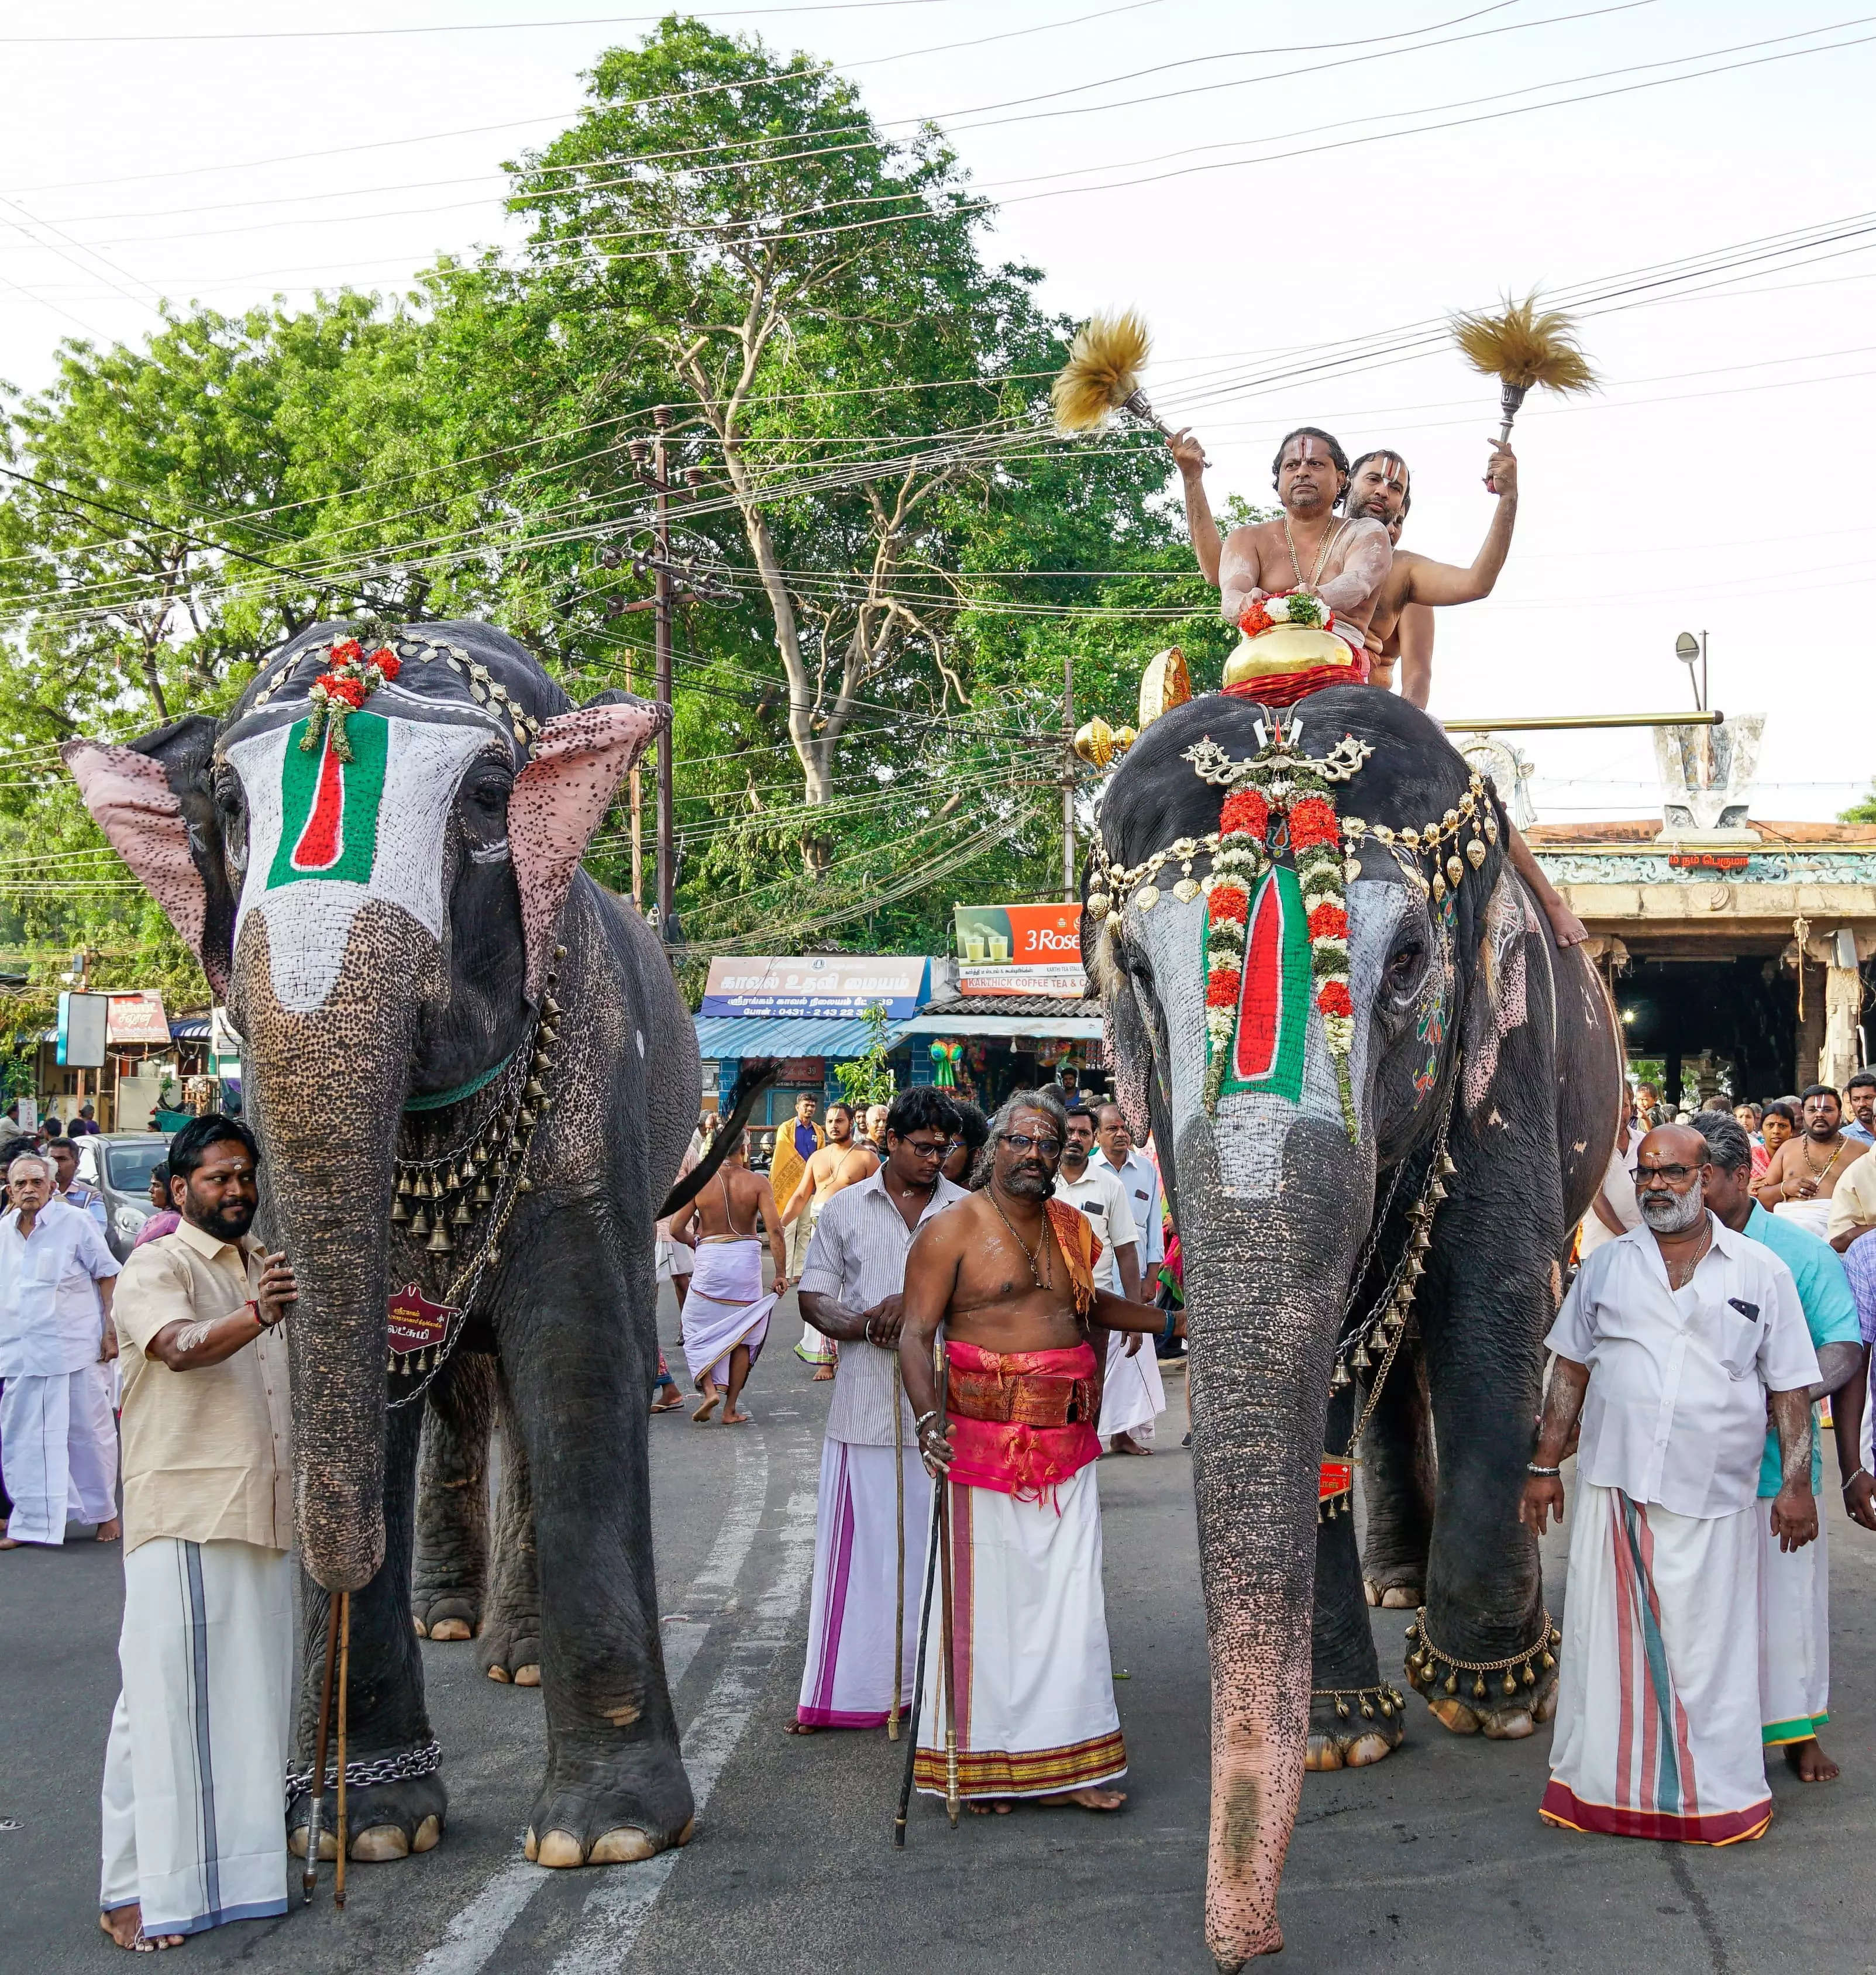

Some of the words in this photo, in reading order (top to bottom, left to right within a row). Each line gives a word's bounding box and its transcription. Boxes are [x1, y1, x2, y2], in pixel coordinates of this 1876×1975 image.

[1025, 930, 1037, 950] 3
[1039, 930, 1081, 950] Rose
[720, 972, 779, 990] காவல்
[785, 973, 839, 994] உதவி
[844, 973, 910, 990] மையம்
[969, 978, 1012, 987] KARTHICK
[1016, 979, 1048, 987] COFFEE
[1051, 979, 1068, 988] TEA
[1070, 979, 1076, 987] &
[776, 997, 807, 1005] காவல்
[809, 997, 852, 1006] நிலையம்
[743, 1007, 771, 1016] போன்
